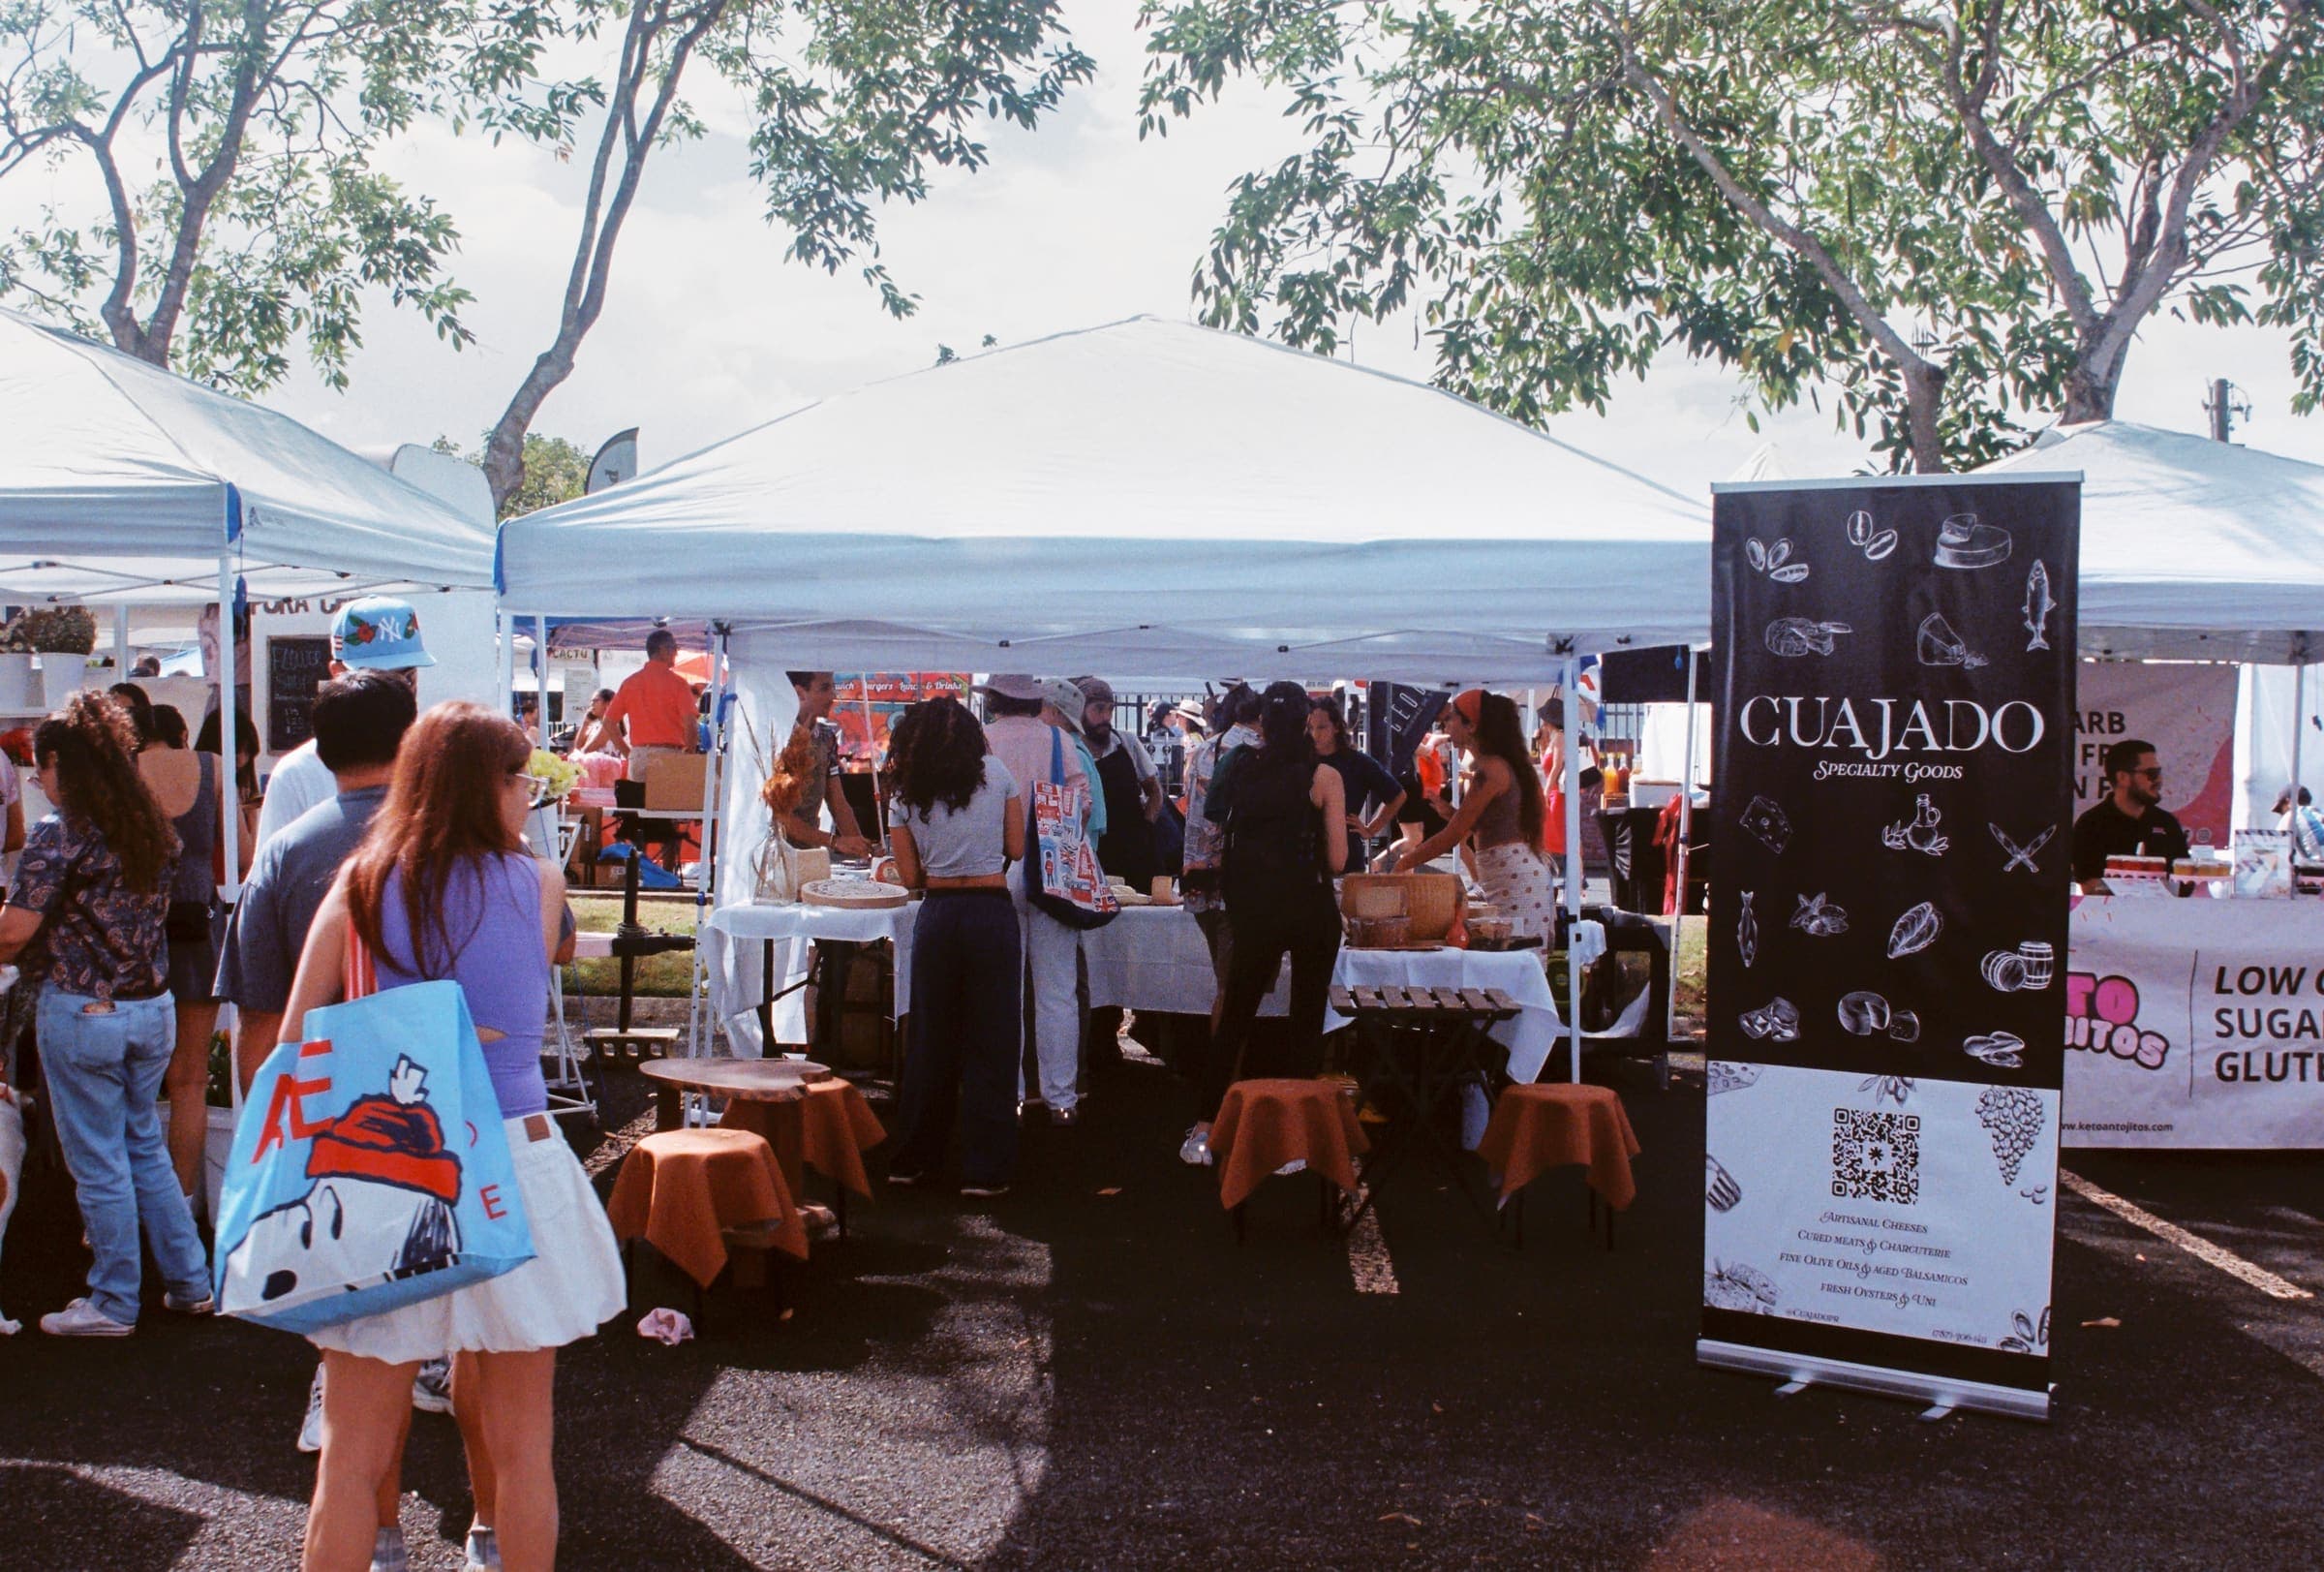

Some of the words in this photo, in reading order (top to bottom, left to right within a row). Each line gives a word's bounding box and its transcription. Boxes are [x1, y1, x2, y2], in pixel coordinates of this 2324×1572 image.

[378, 616, 402, 643] NY
[1738, 694, 2046, 760] CUAJADO
[1813, 759, 1901, 781] SPECIALTY
[1904, 761, 1964, 784] GOODS
[2215, 965, 2307, 996] LOW
[2215, 1007, 2324, 1039] SUGA
[1797, 1229, 1832, 1243] CURED
[1834, 1236, 1865, 1248] MEATS
[1881, 1218, 1929, 1234] CHEESES
[1803, 1254, 1834, 1268] OLIVE
